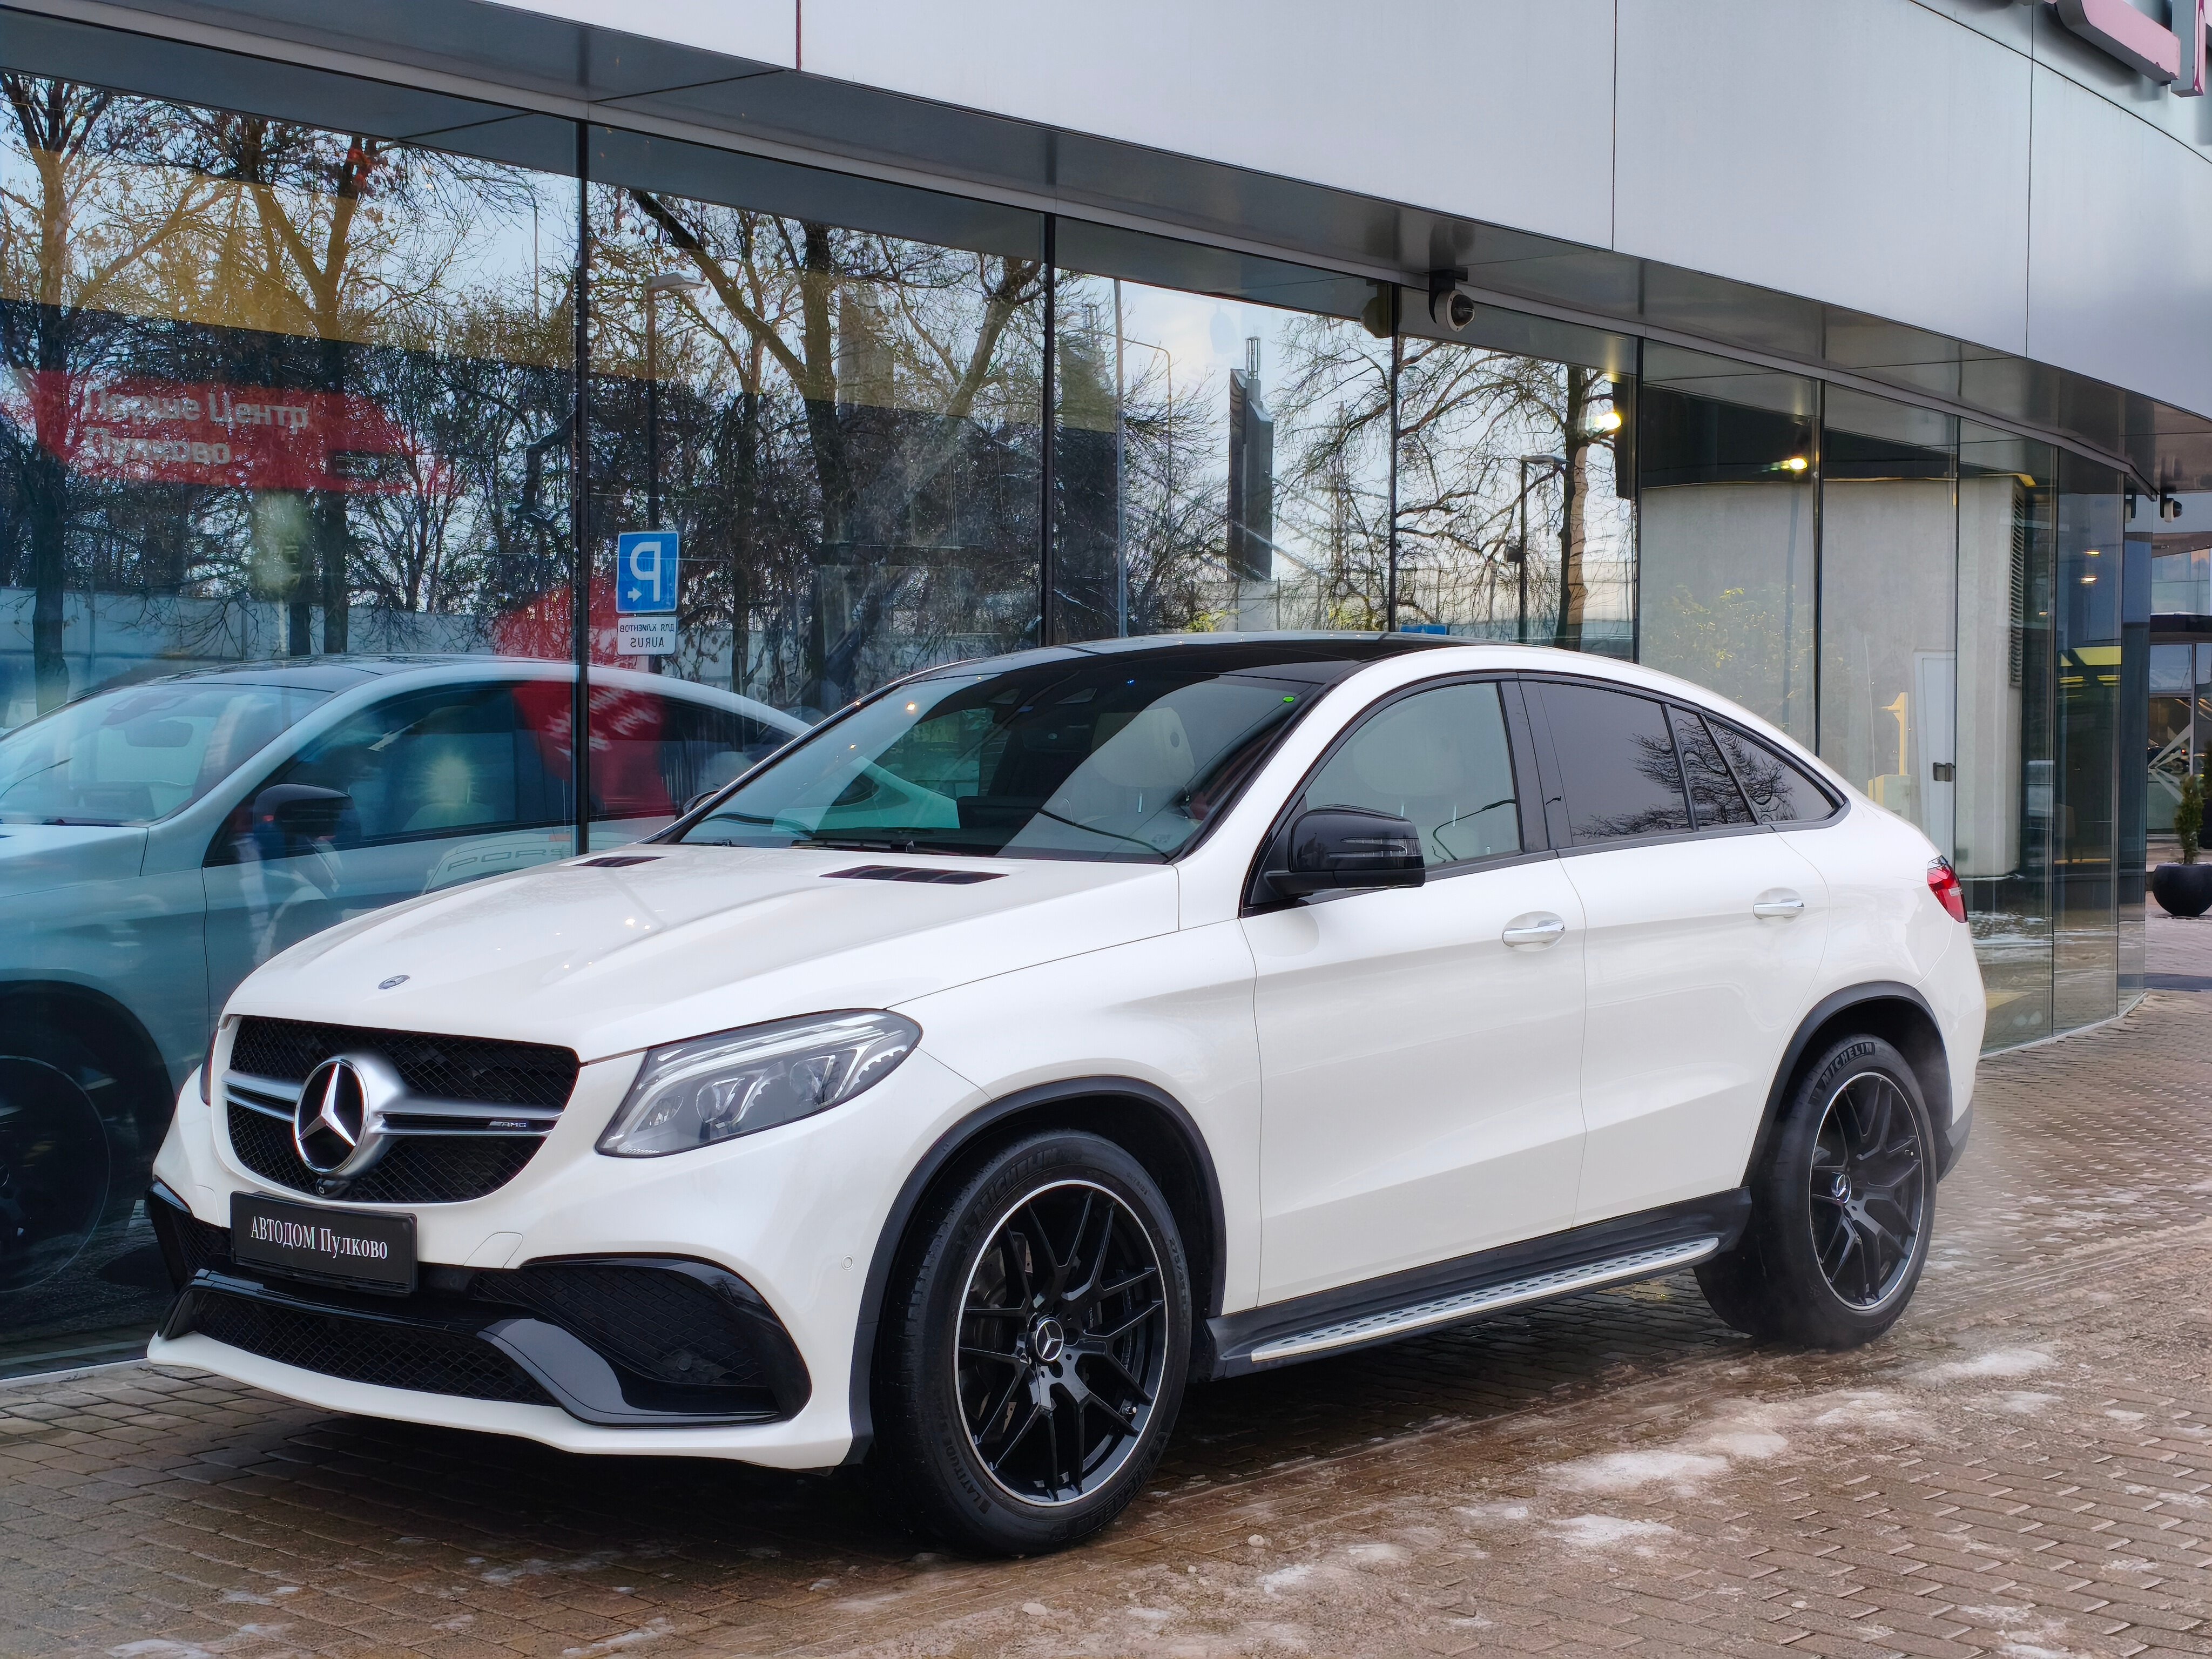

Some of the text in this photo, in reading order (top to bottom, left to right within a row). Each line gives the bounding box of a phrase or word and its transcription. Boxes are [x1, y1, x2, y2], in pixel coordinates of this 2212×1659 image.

[210, 392, 307, 434] Центр
[1822, 1042, 1874, 1088] MICHELIN
[973, 1148, 1057, 1225] MICHELIN
[251, 1216, 388, 1259] АВТОДОМ Пулково
[942, 1437, 982, 1503] LATITUDE
